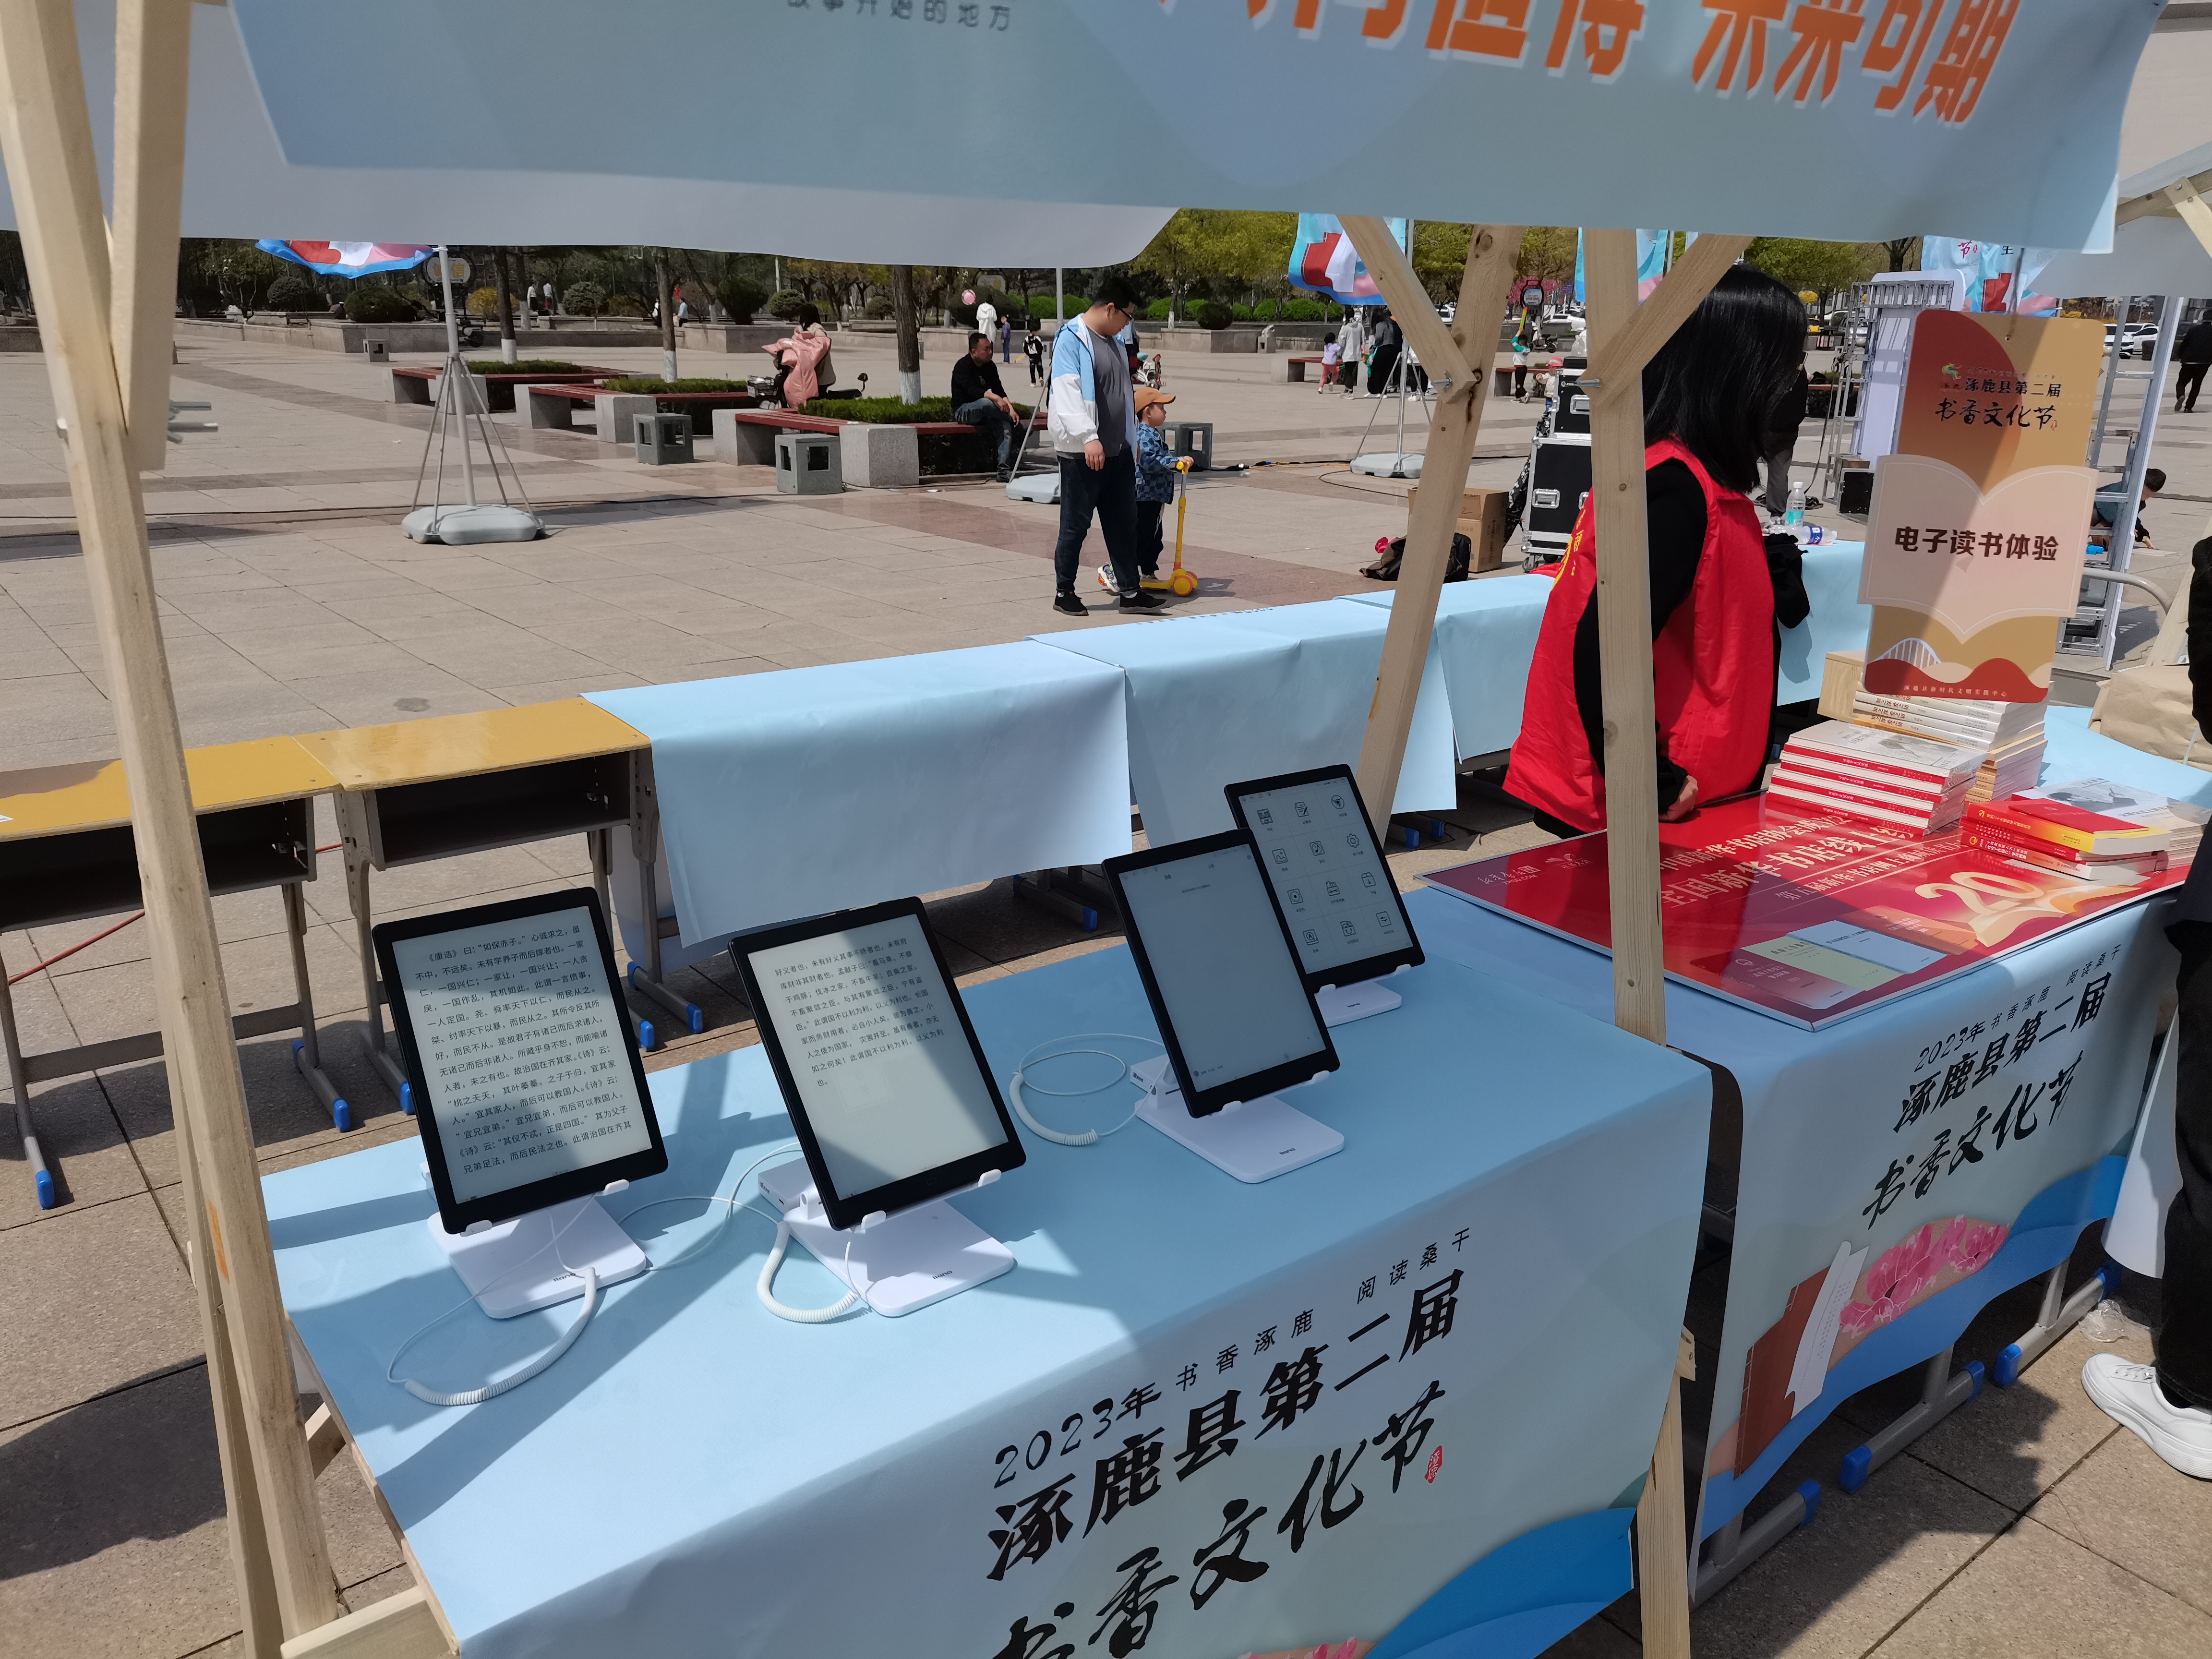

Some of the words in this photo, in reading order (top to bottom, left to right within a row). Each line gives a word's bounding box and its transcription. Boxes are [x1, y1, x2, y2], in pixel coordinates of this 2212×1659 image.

[1936, 398, 2056, 430] 书香文化节
[1965, 378, 2061, 397] 涿鹿县第二届
[1895, 526, 2059, 561] 电子读书体验
[1893, 971, 2112, 1133] 涿鹿县第二届
[1863, 1050, 2083, 1230] 书香文化节
[1356, 1227, 1469, 1305] 阅读桑干
[986, 1269, 1464, 1581] 涿鹿县第二届
